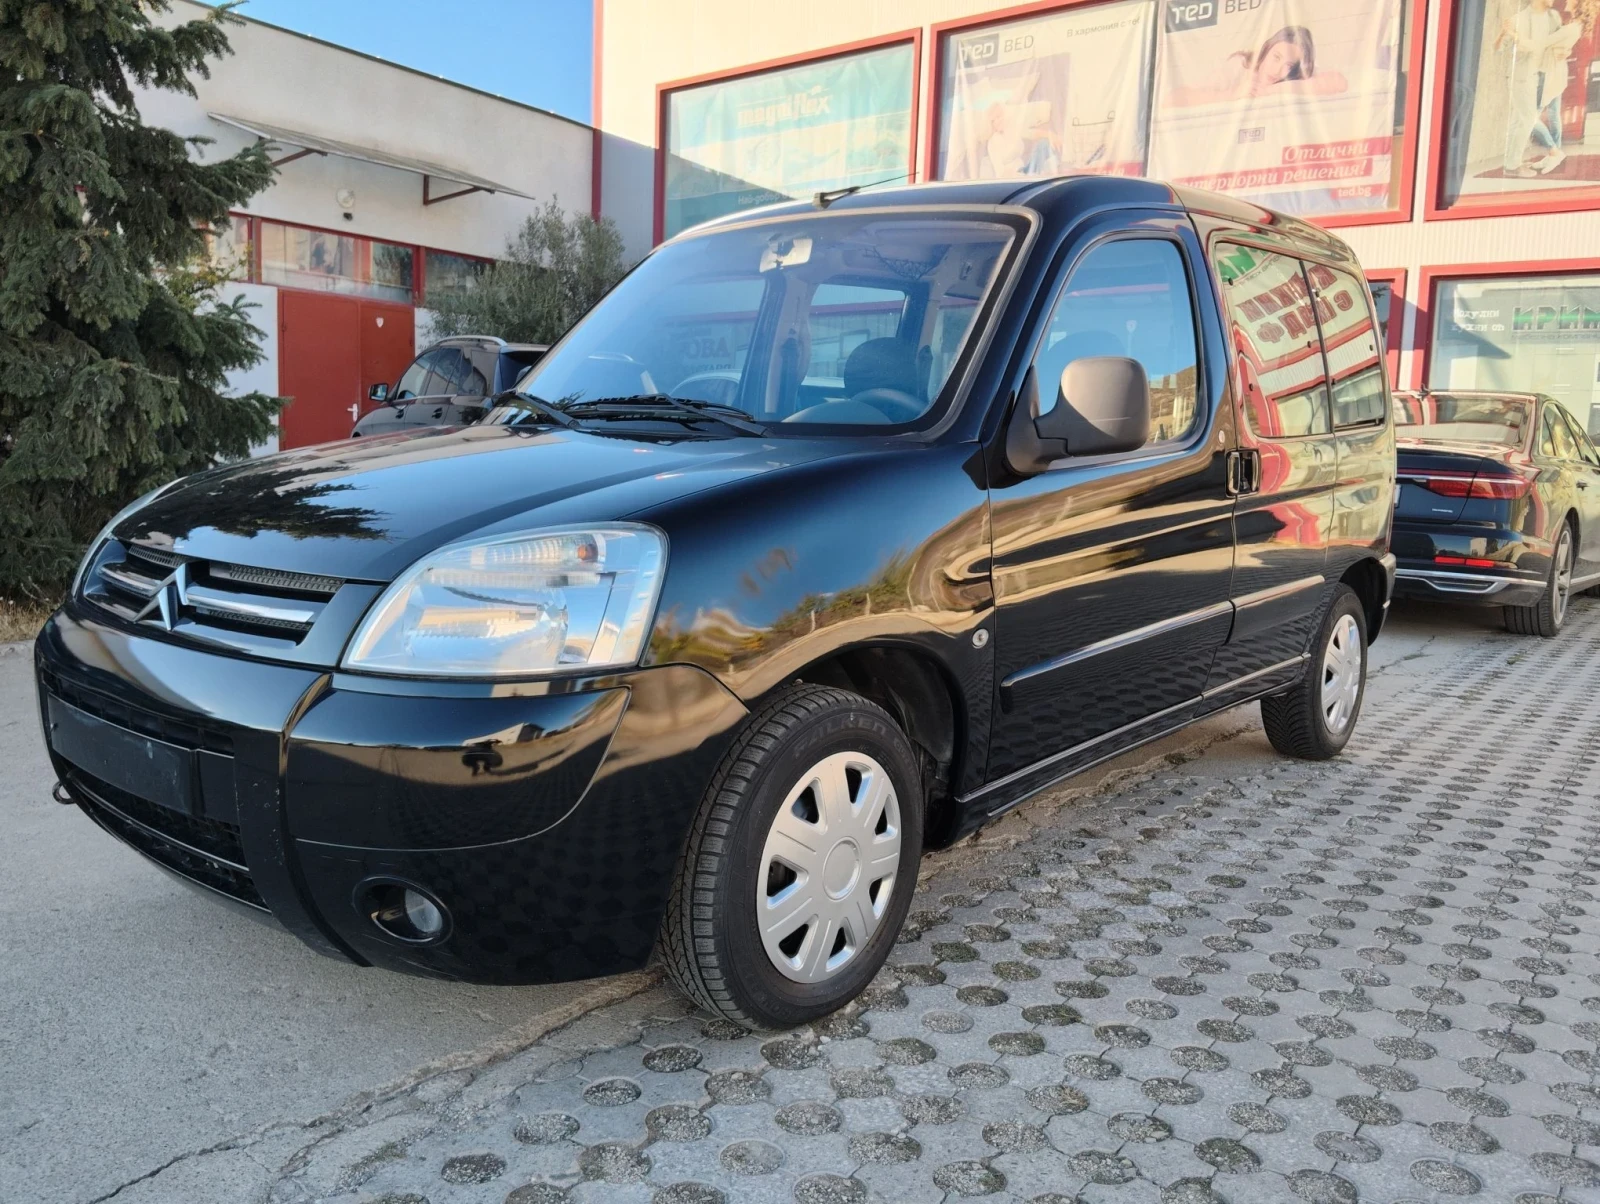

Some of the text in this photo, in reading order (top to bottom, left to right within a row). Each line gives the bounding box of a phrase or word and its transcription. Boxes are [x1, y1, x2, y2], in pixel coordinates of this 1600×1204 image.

[1224, 0, 1262, 14] BED
[1003, 34, 1034, 54] BED
[1284, 143, 1369, 162] Отлични
[1183, 160, 1367, 190] нтериорни решения!
[1337, 185, 1372, 197] ted.bg
